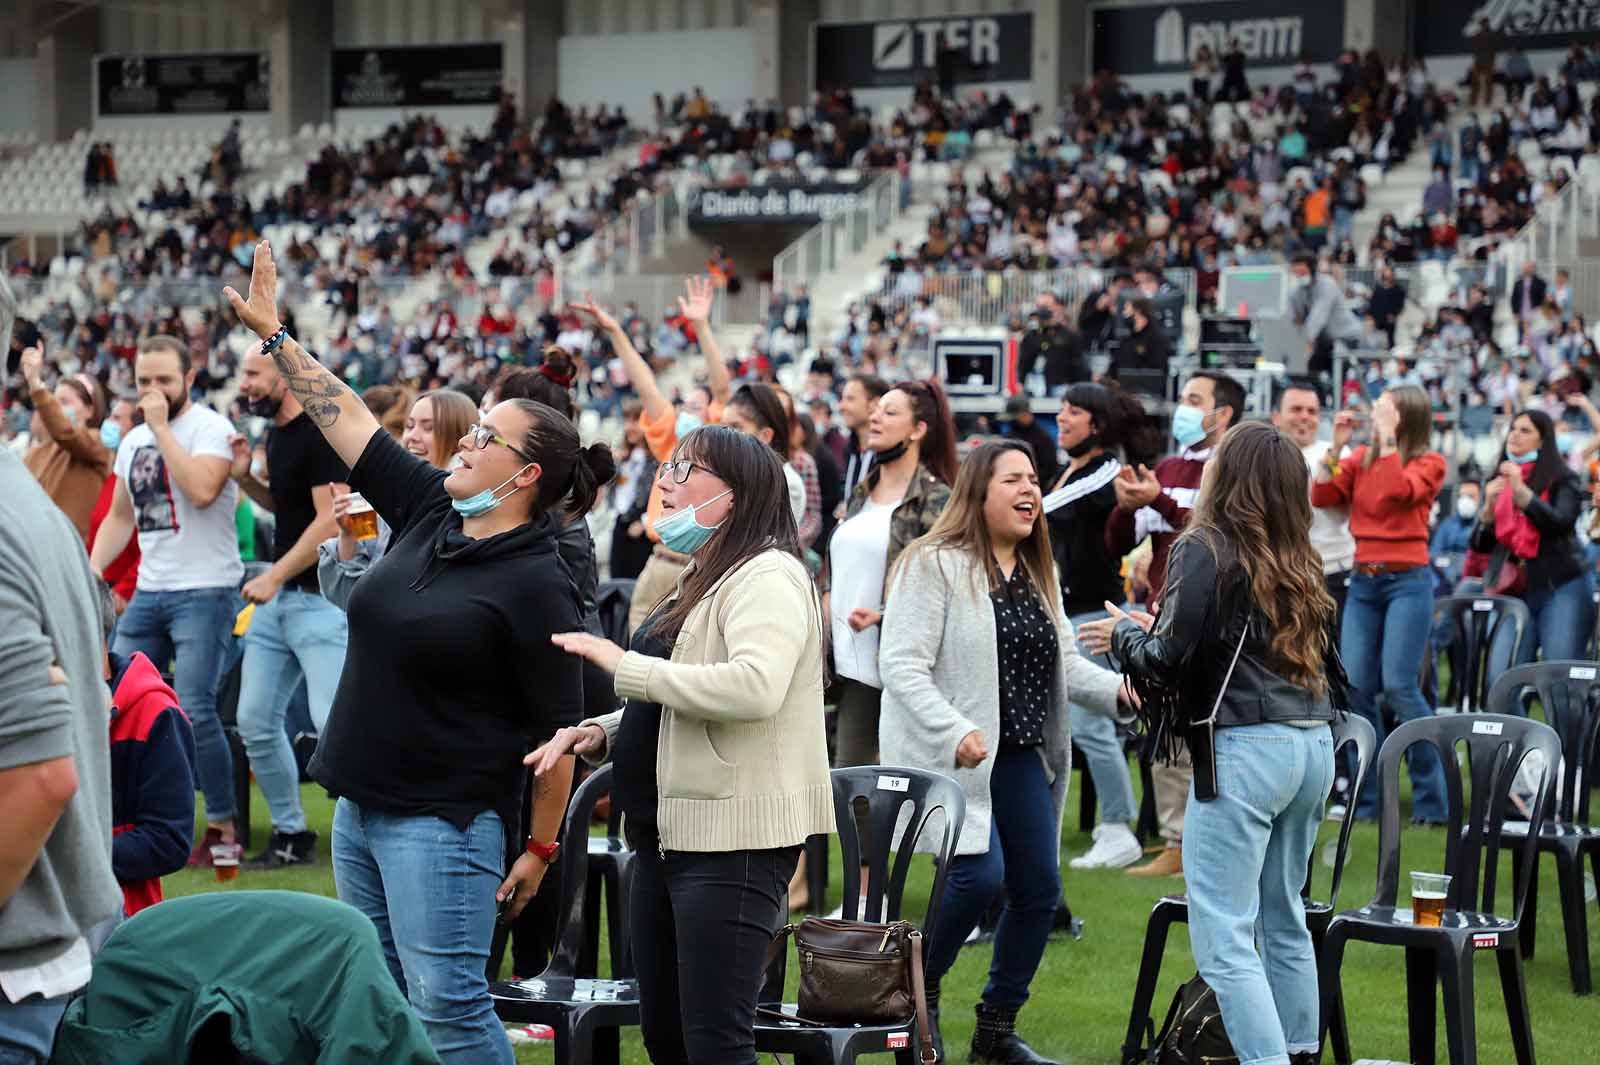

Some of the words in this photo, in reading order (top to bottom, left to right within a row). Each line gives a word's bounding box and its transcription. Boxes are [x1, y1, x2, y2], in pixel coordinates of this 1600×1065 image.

[701, 189, 760, 217] Diario
[760, 188, 787, 216] de
[890, 779, 900, 788] 19
